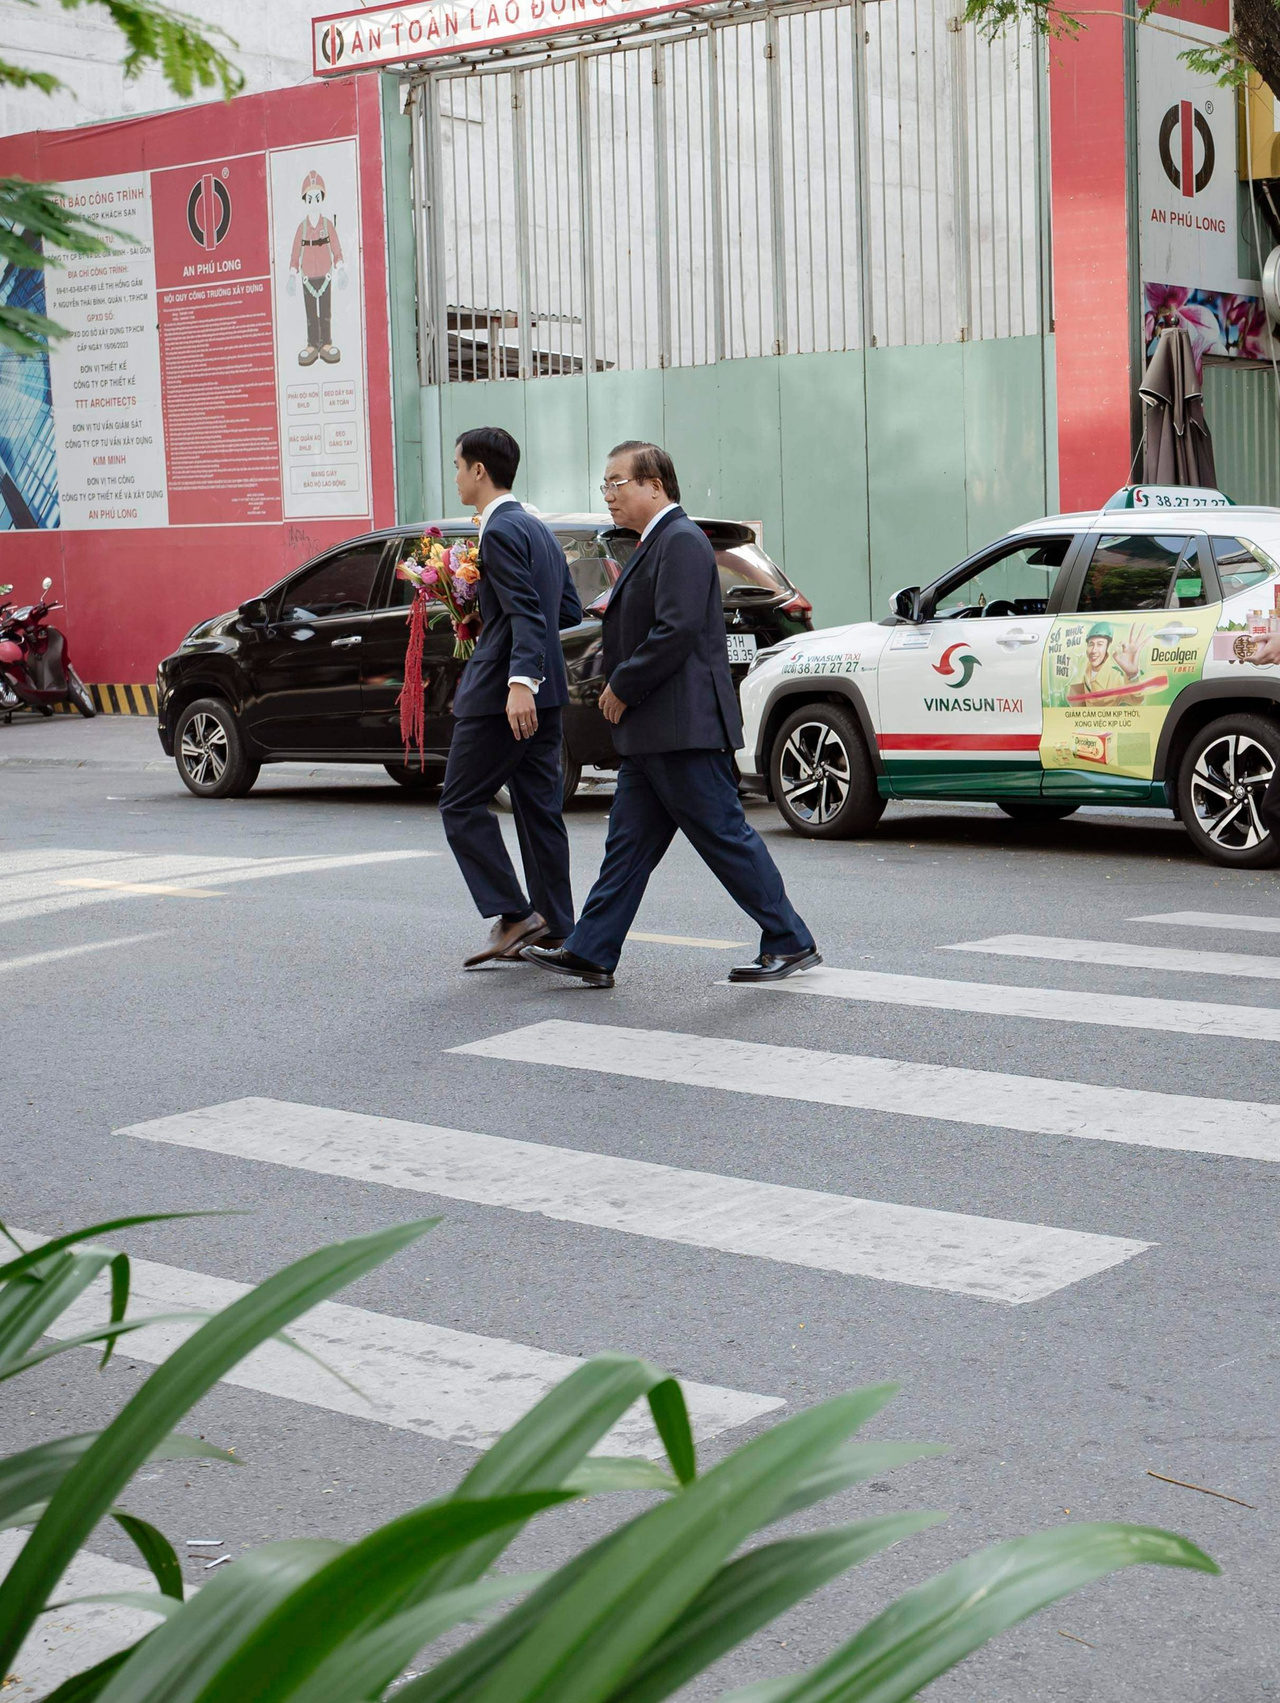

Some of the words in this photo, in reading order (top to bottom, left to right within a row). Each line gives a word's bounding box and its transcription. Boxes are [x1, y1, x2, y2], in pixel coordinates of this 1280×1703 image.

[351, 28, 381, 54] AN
[391, 9, 458, 46] TOÀN
[470, 0, 520, 31] LAO
[88, 191, 114, 206] CÔNG
[116, 186, 145, 200] TRÌNH
[1151, 208, 1166, 224] AN
[1170, 210, 1193, 227] PHÚ
[1195, 217, 1226, 233] LONG
[183, 265, 195, 277] AN
[196, 260, 215, 275] PHÚ
[217, 259, 242, 273] LONG
[100, 379, 109, 388] CP
[75, 399, 88, 409] TTT
[90, 396, 137, 408] ARCHITECTS
[92, 456, 106, 465] KIM
[107, 455, 126, 465] MINH
[88, 510, 99, 519] AN
[100, 507, 116, 519] PHÚ
[116, 509, 137, 519] LONG
[807, 654, 843, 662] VINASUN
[1151, 647, 1197, 664] Decolgen
[797, 662, 825, 674] 38.27
[830, 662, 843, 673] 27
[845, 661, 859, 673] 27
[924, 698, 995, 712] VINASUN
[996, 698, 1023, 713] TAXI
